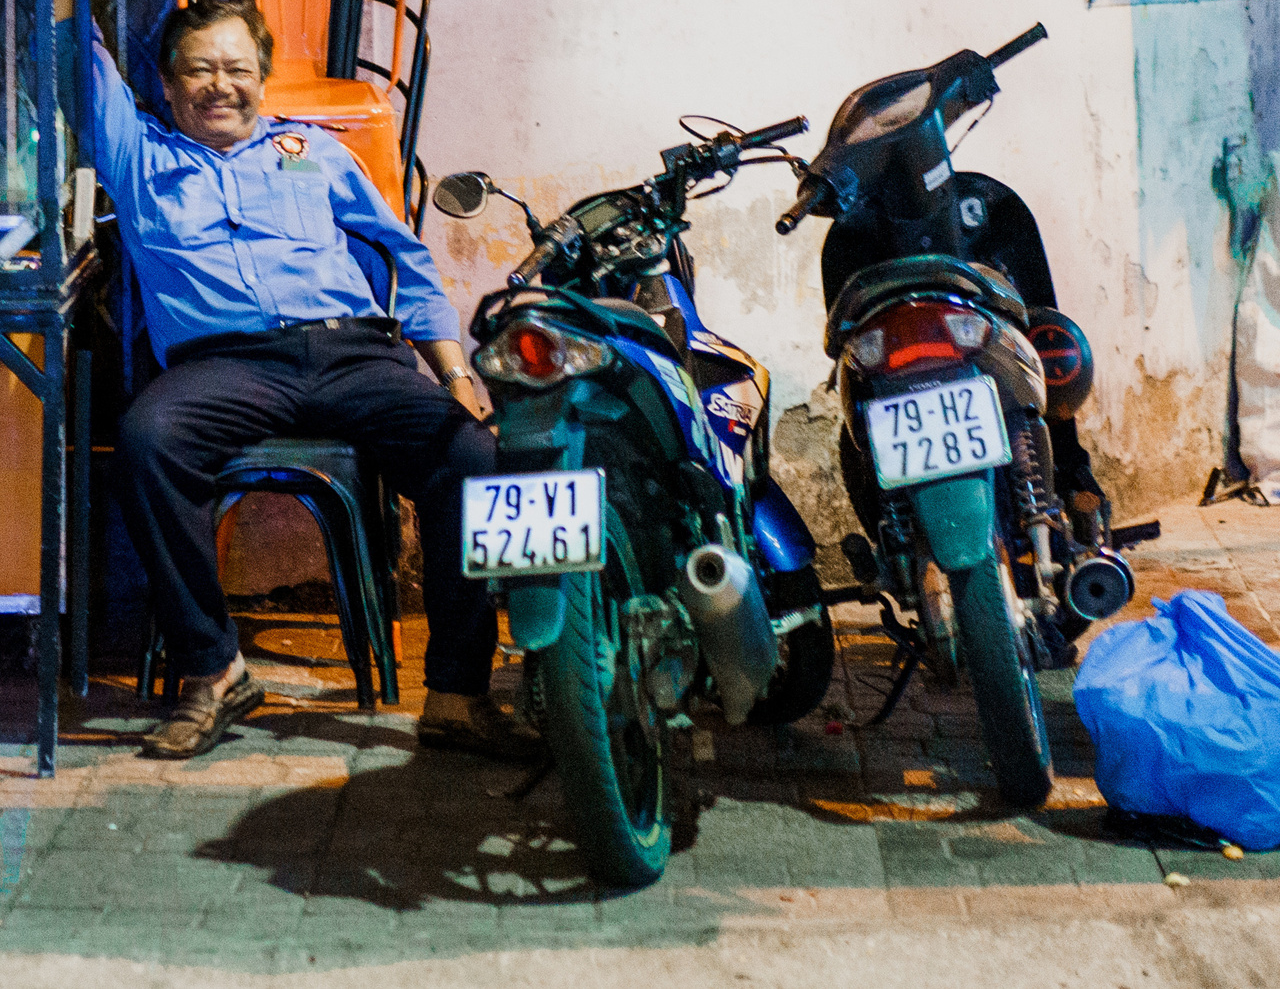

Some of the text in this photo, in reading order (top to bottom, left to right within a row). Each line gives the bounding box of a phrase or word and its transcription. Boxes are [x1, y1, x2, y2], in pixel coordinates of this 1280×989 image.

[884, 388, 979, 437] 79-H2
[892, 425, 988, 477] 7285
[485, 481, 576, 522] 79-V1
